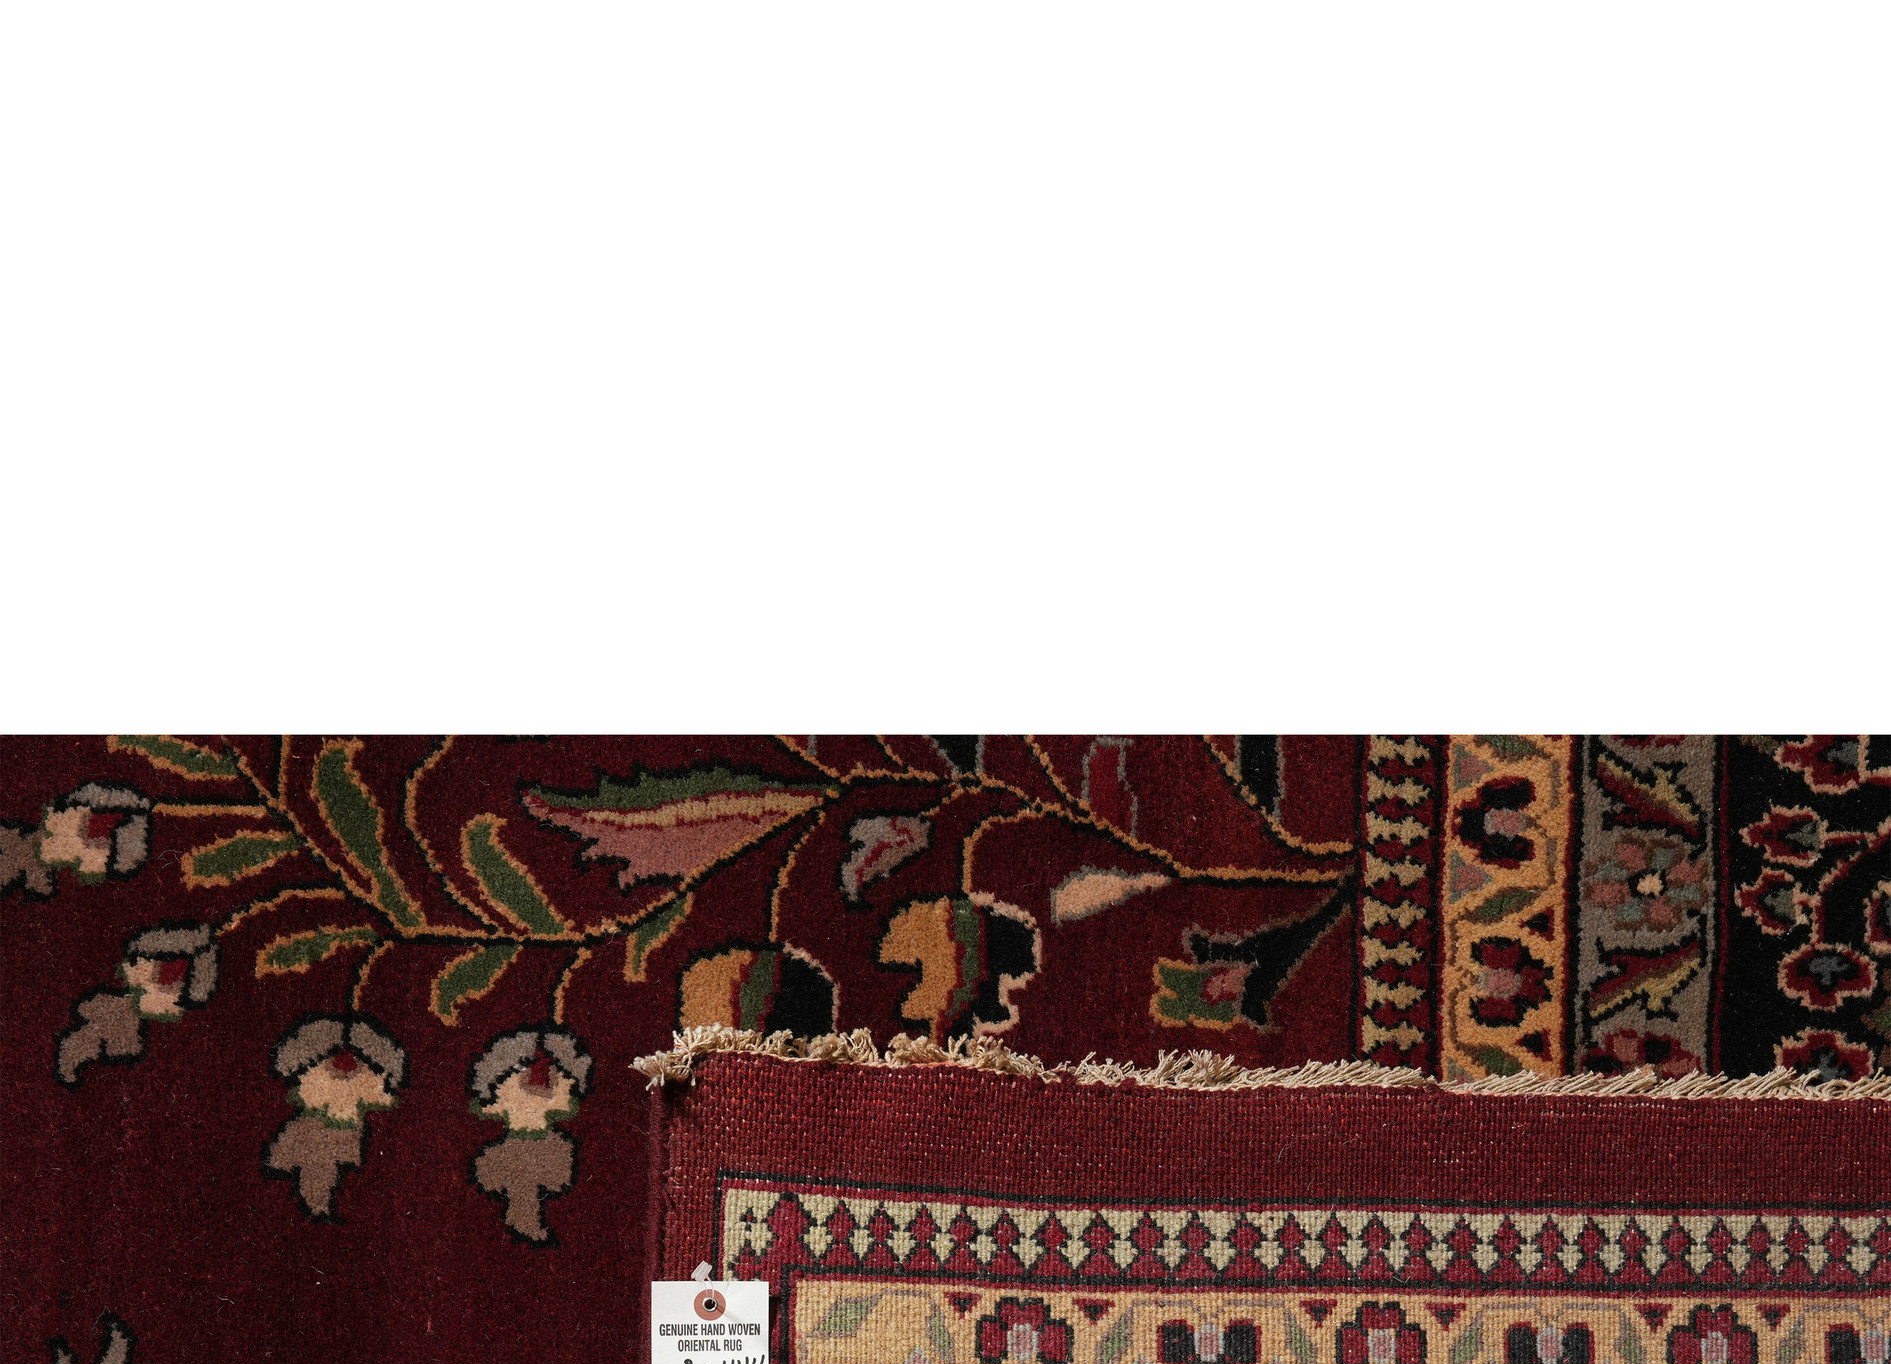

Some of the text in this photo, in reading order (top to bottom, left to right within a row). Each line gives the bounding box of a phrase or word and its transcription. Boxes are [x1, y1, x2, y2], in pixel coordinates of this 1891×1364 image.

[659, 1323, 761, 1336] GENUINE HAND WOVEN
[677, 1339, 743, 1352] ORIENTAL RUG
